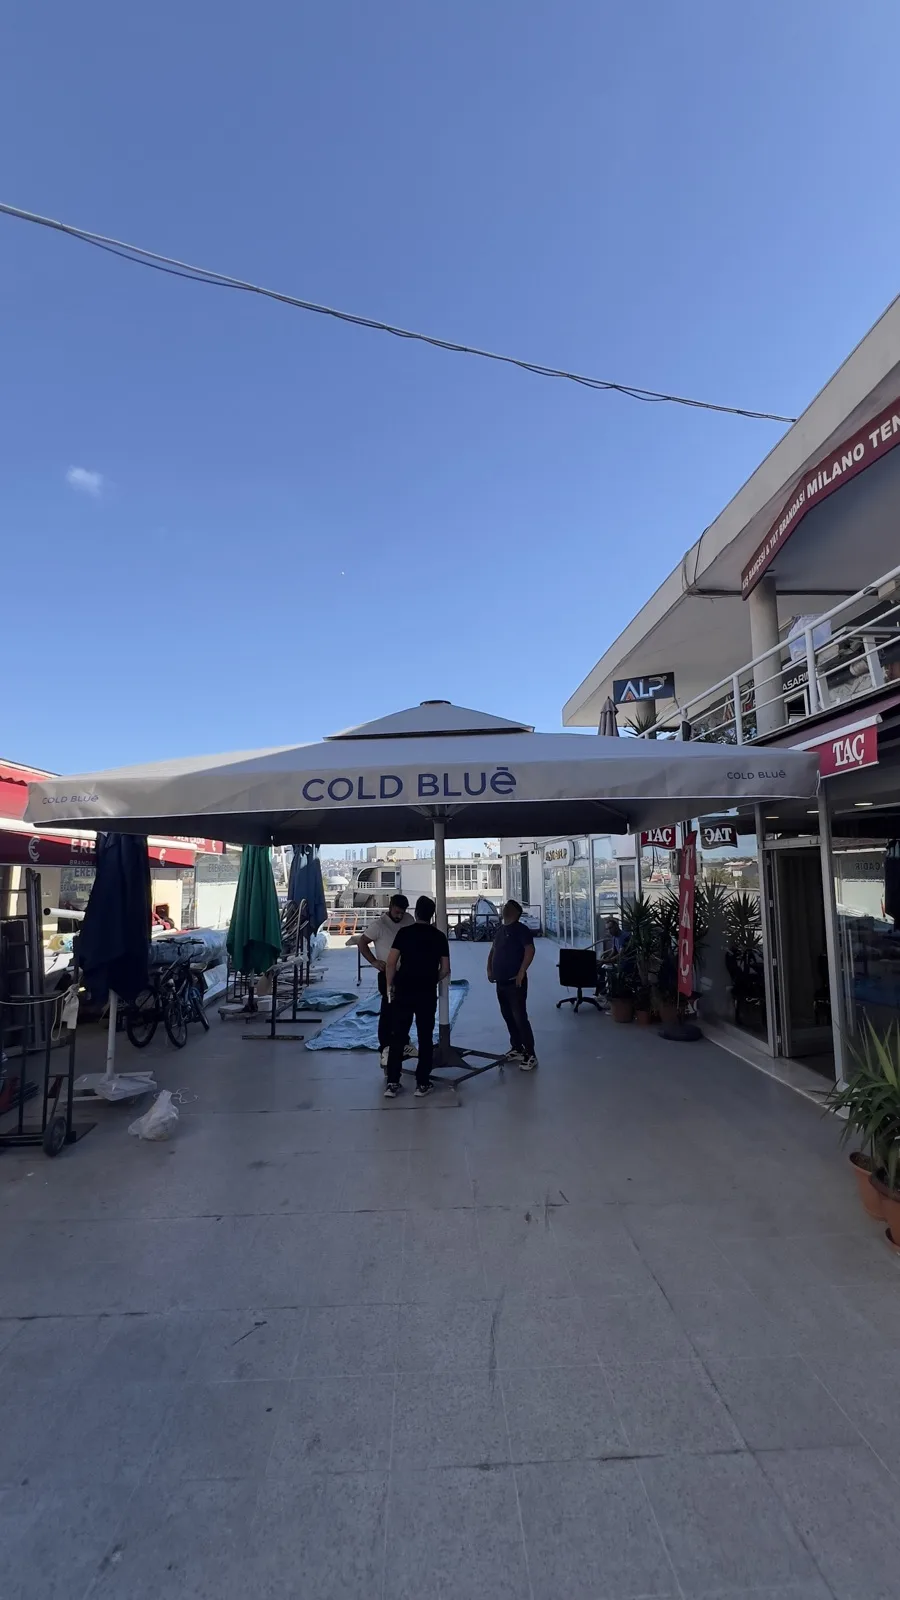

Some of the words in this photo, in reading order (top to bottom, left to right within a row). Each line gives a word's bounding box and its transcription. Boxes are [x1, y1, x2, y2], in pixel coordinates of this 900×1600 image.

[806, 443, 865, 499] MİLANO
[620, 676, 667, 702] ALP
[832, 733, 865, 767] TAÇ
[302, 774, 404, 801] COLD
[727, 771, 755, 780] COLD
[42, 796, 68, 805] COLD
[646, 828, 672, 845] TAÇ
